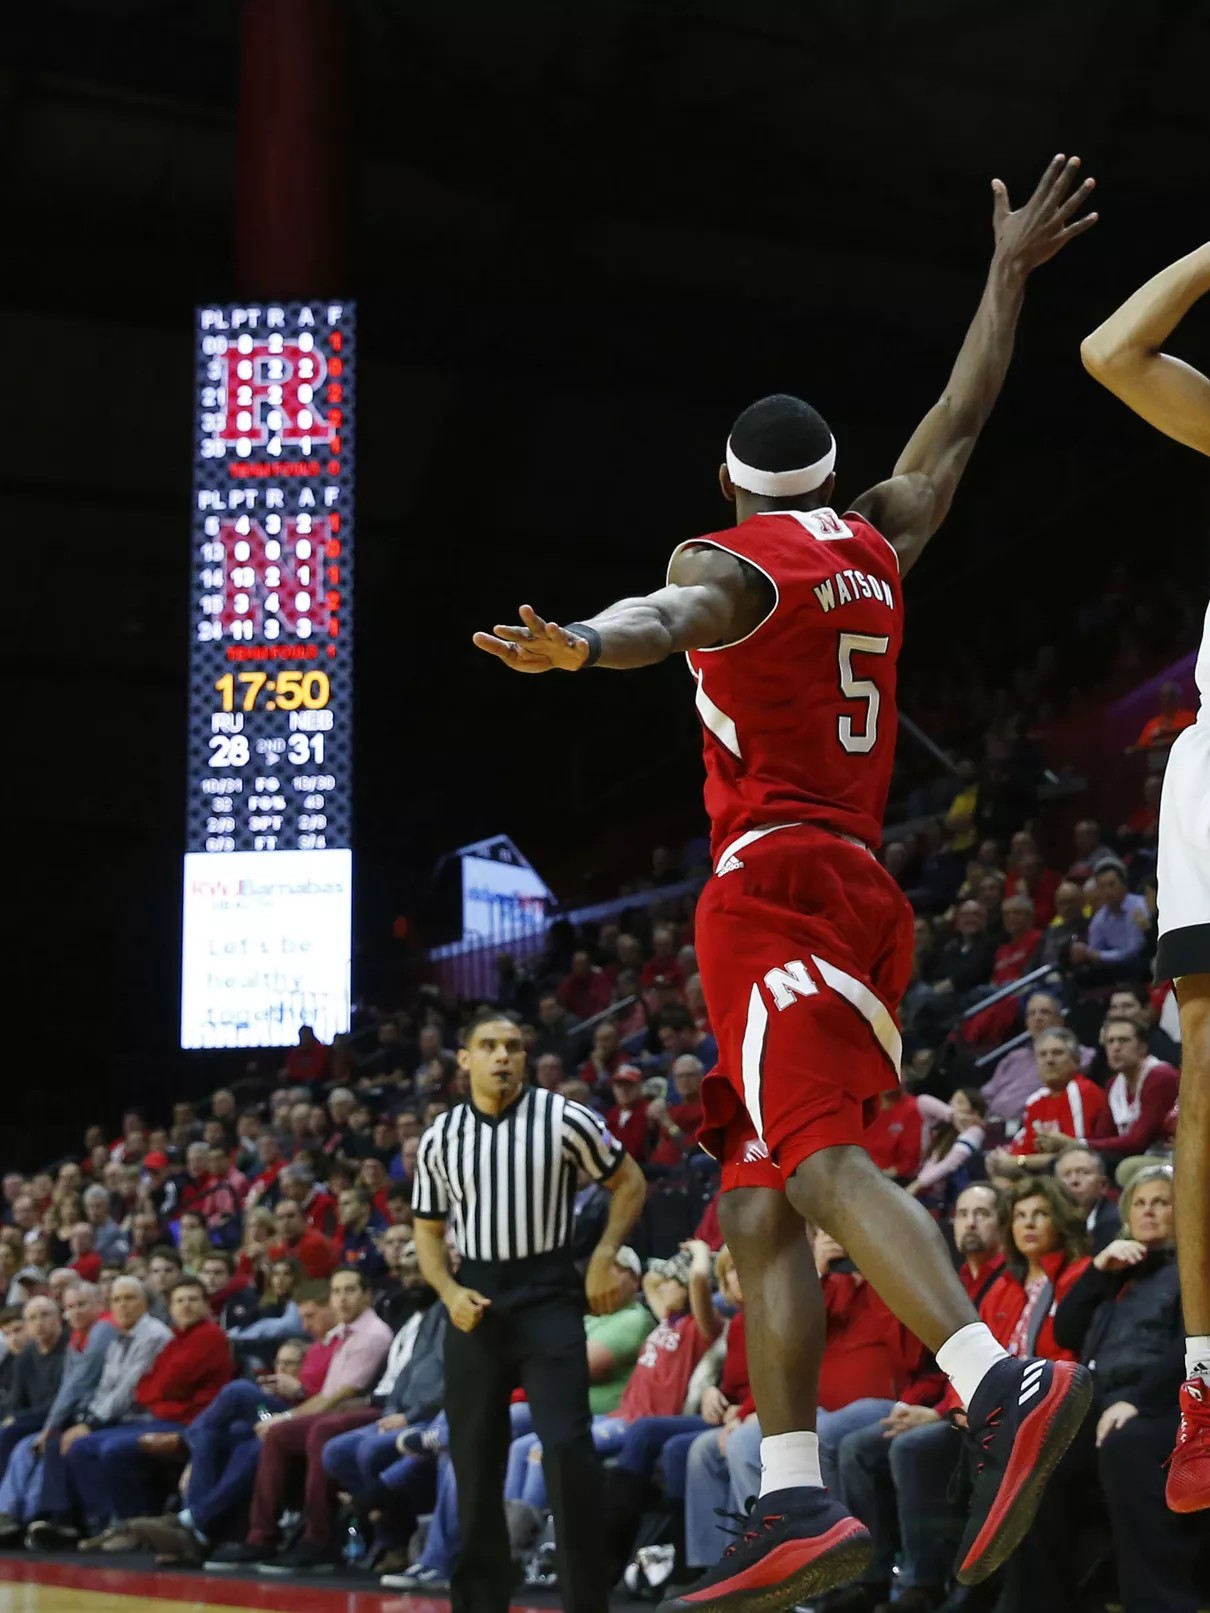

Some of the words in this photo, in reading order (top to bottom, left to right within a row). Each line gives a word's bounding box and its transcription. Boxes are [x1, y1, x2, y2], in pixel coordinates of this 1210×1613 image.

[202, 310, 229, 329] PL
[231, 308, 261, 329] PT
[267, 308, 285, 327] R
[298, 307, 315, 327] A
[327, 306, 343, 326] F
[268, 333, 283, 353] 2
[298, 358, 313, 378] 2
[237, 385, 252, 406] 2
[267, 436, 282, 456] 4
[301, 435, 311, 456] 1
[198, 490, 226, 510] PL
[229, 489, 258, 509] PT
[266, 488, 284, 508] R
[299, 487, 315, 507] A
[324, 486, 340, 506] F
[235, 515, 250, 535] 4
[266, 514, 281, 534] 3
[296, 513, 312, 533] 2
[815, 514, 842, 534] N
[265, 566, 280, 587] 2
[297, 565, 310, 586] 1
[328, 565, 340, 585] 1
[813, 569, 894, 613] WATSON
[234, 593, 249, 614] 3
[265, 592, 280, 613] 4
[229, 620, 253, 640] 11
[264, 619, 279, 639] 3
[215, 670, 330, 711] 17:50
[837, 632, 889, 754] 5
[211, 712, 244, 733] RU
[289, 710, 333, 732] NEB
[208, 735, 249, 767] 28
[288, 733, 324, 765] 31
[254, 835, 278, 851] FT
[763, 960, 820, 1012] N
